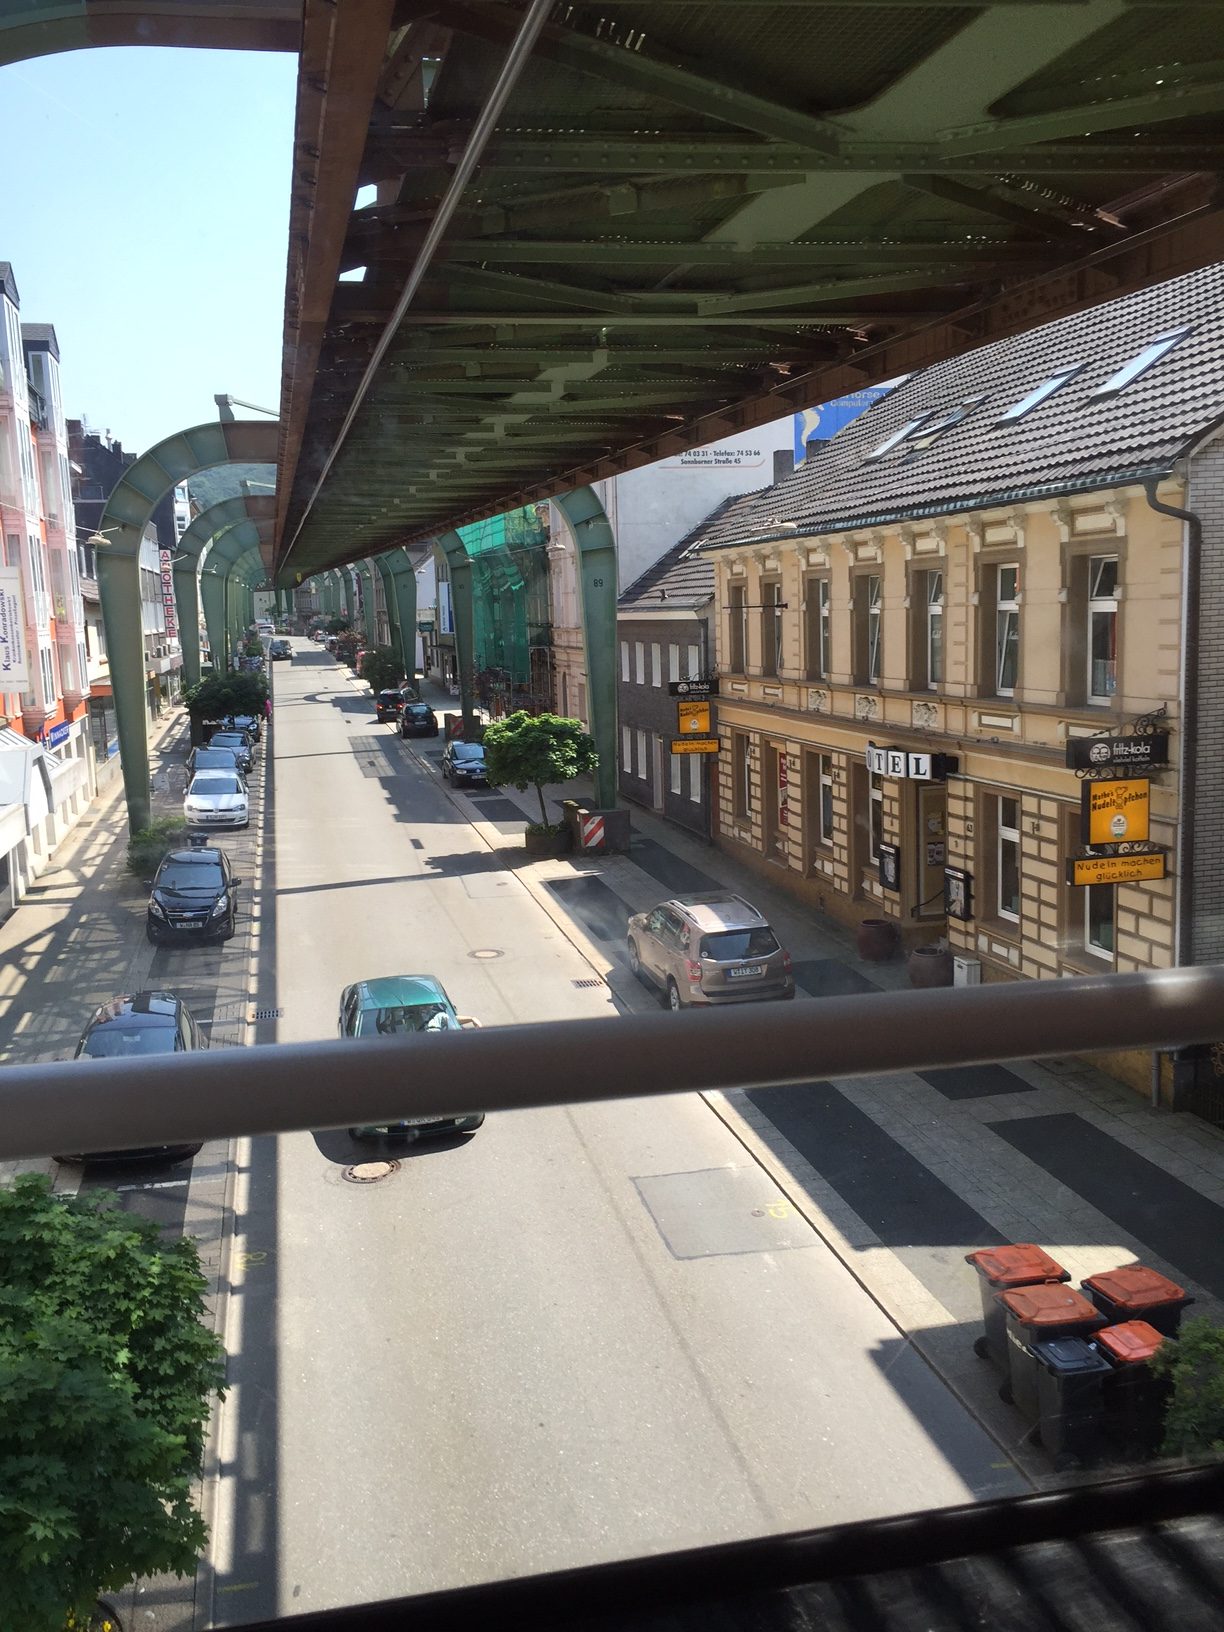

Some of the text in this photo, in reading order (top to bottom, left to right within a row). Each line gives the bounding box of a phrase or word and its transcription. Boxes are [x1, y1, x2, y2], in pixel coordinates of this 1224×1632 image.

[593, 578, 604, 588] 89
[2, 646, 11, 671] Klaus
[1113, 741, 1151, 756] fritz-kola
[1077, 857, 1161, 871] Nudeln machen
[1096, 869, 1142, 882] glücklich
